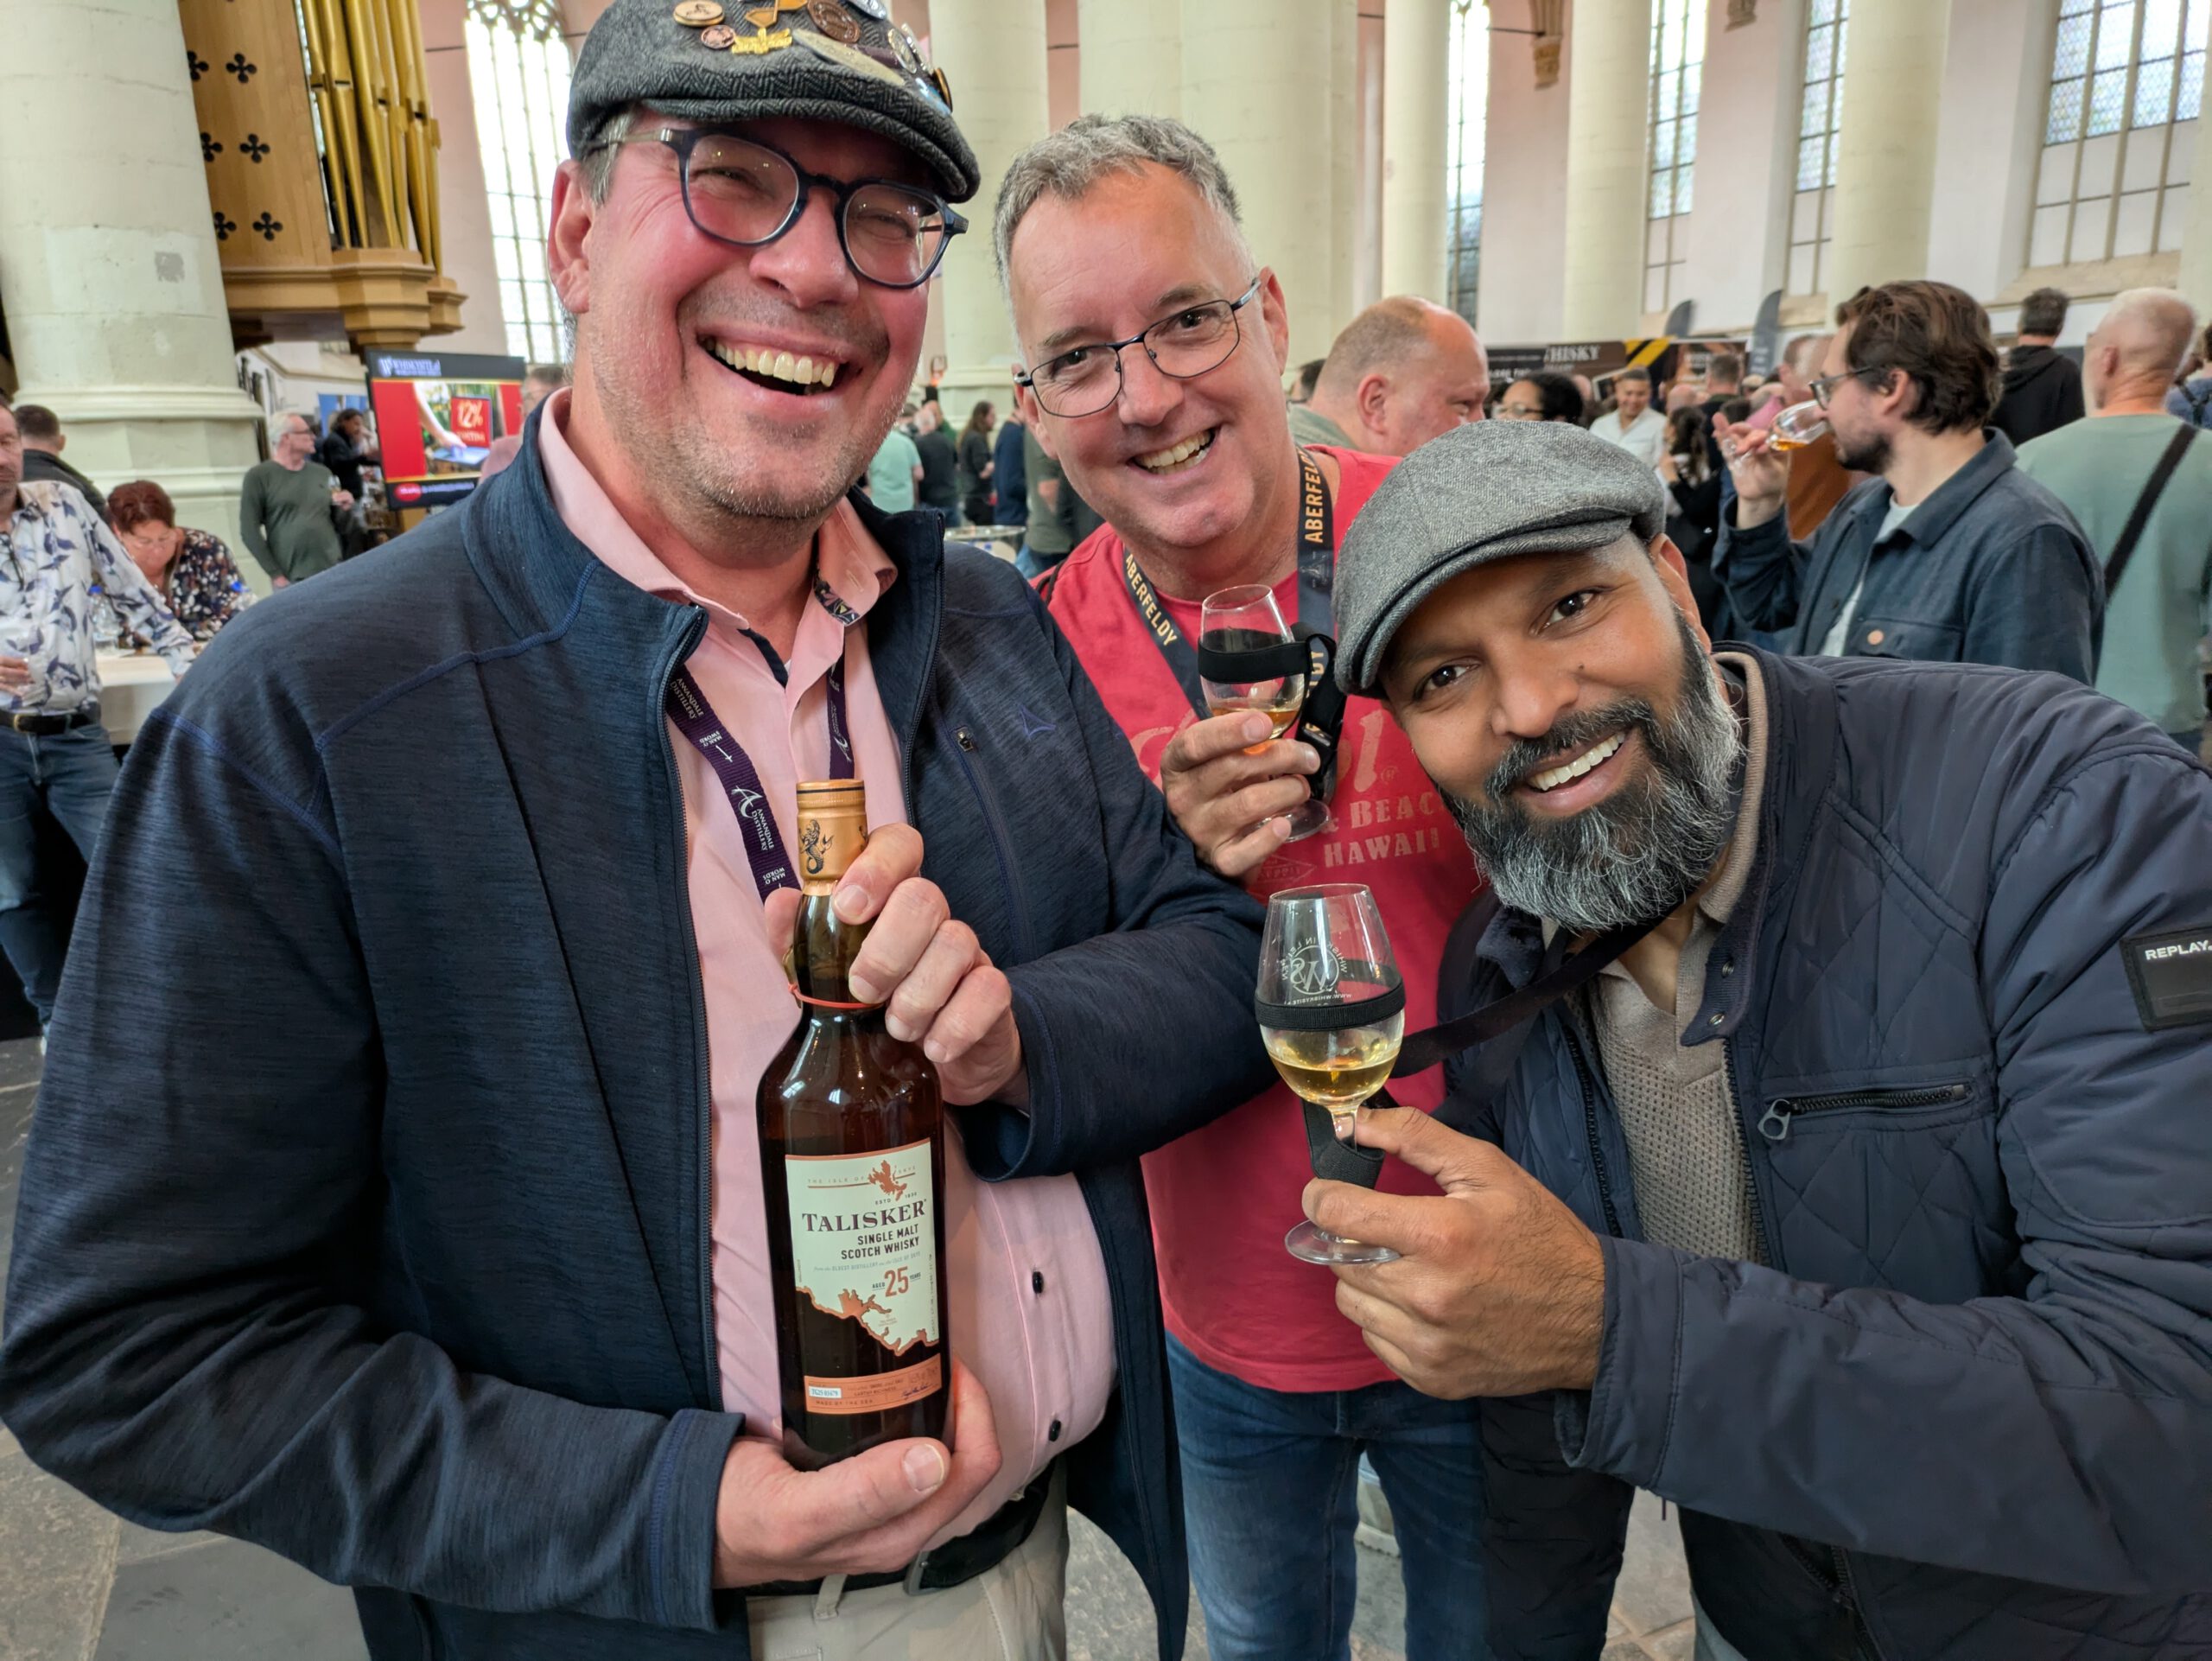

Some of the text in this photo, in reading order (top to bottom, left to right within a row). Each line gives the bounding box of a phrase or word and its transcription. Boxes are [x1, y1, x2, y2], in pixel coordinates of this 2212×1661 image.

[457, 400, 484, 429] 12%
[1125, 553, 1178, 646] ABERFELDY
[670, 680, 697, 720] DISTILLERY
[676, 677, 704, 716] ANNANDALE
[709, 735, 722, 745] MAN
[1350, 792, 1444, 830] BEAC
[751, 810, 768, 851] DISTILLERY
[756, 808, 775, 850] ANNANDALE
[1324, 827, 1440, 869] HAWAII
[762, 867, 785, 881] WORDS
[772, 871, 786, 881] MAN
[2145, 939, 2209, 960] REPLAY
[802, 1200, 925, 1232] TALISKER
[841, 1236, 920, 1260] SCOTCH WHISKY
[857, 1223, 919, 1245] SINGLE MALT
[884, 1266, 909, 1297] 25
[910, 1272, 921, 1281] YEARS
